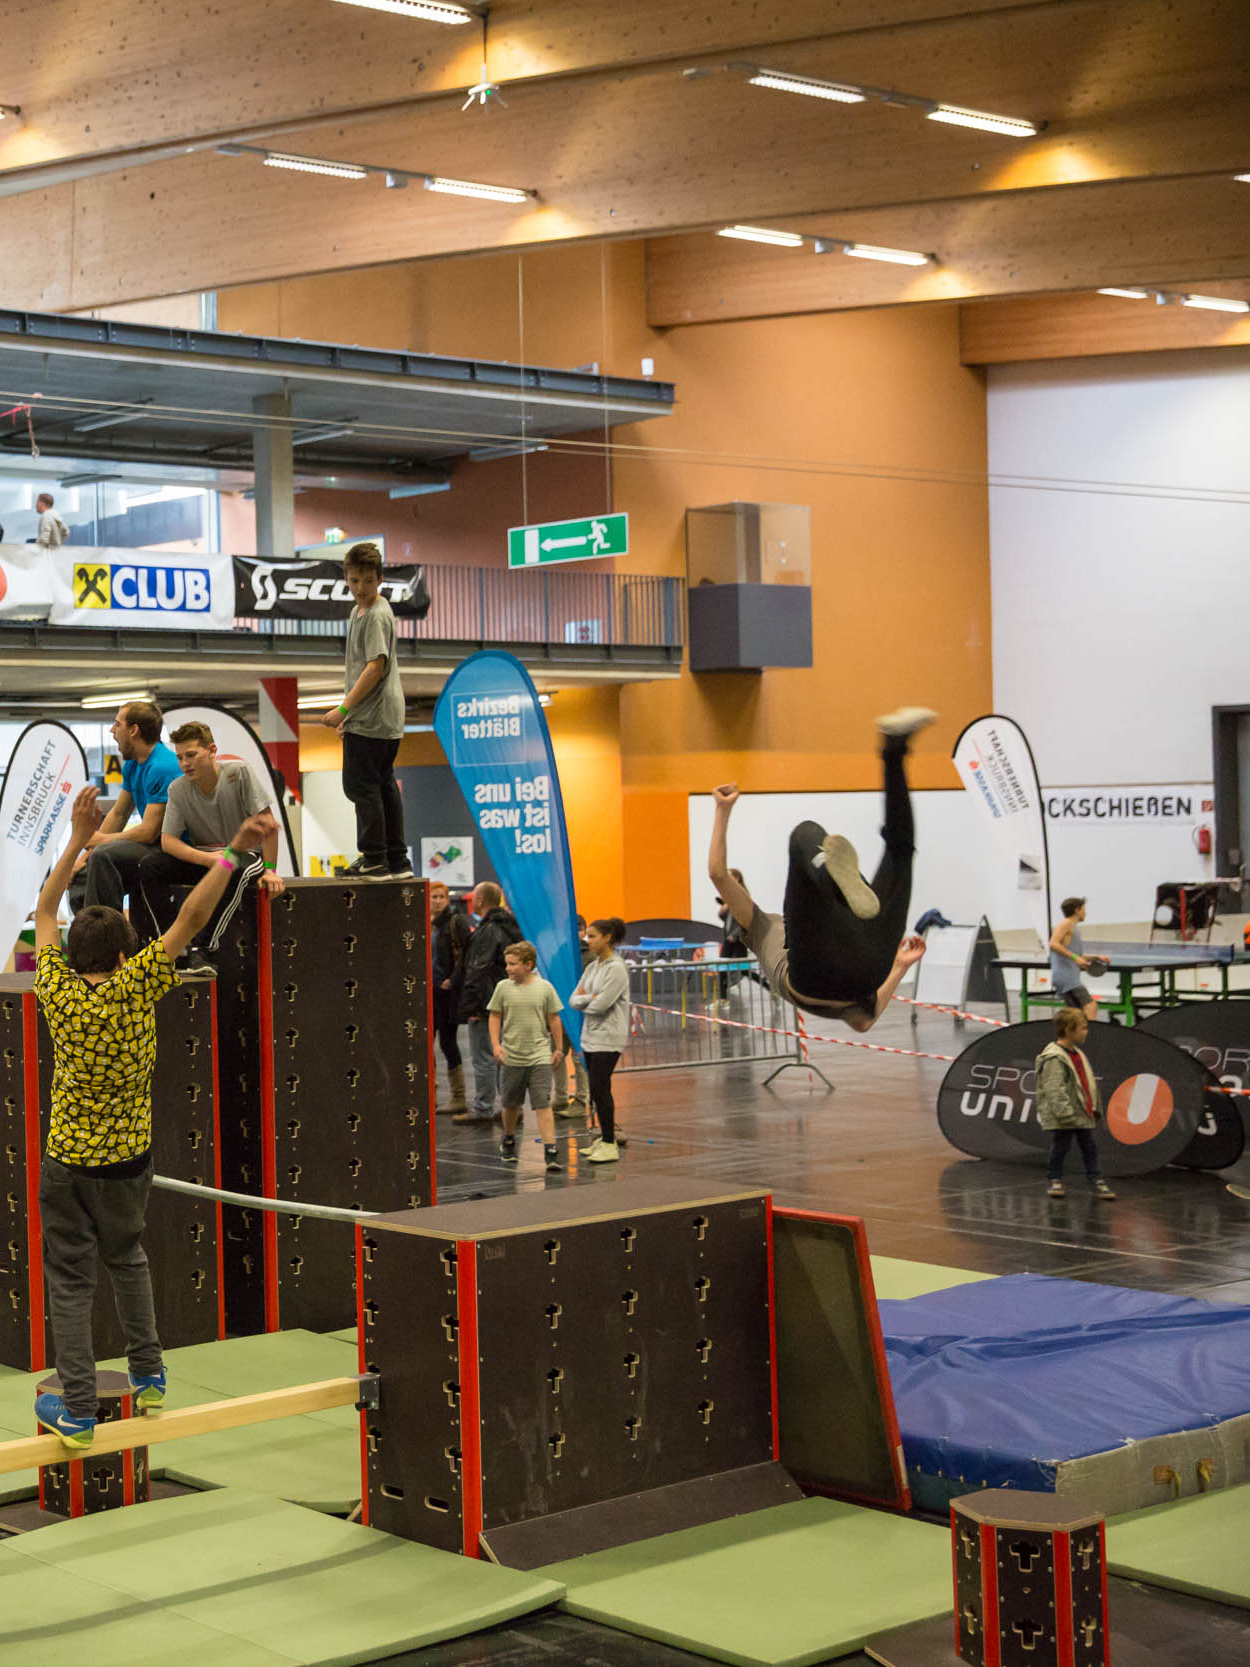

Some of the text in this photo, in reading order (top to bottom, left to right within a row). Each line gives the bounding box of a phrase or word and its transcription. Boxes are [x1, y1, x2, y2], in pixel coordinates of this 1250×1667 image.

[110, 566, 210, 612] CLUB
[6, 739, 57, 841] TURNERSCHAFT
[17, 771, 57, 847] INNSBRUCK
[1043, 796, 1192, 819] CKSCHIEßEN
[36, 792, 68, 857] SPARKASSE
